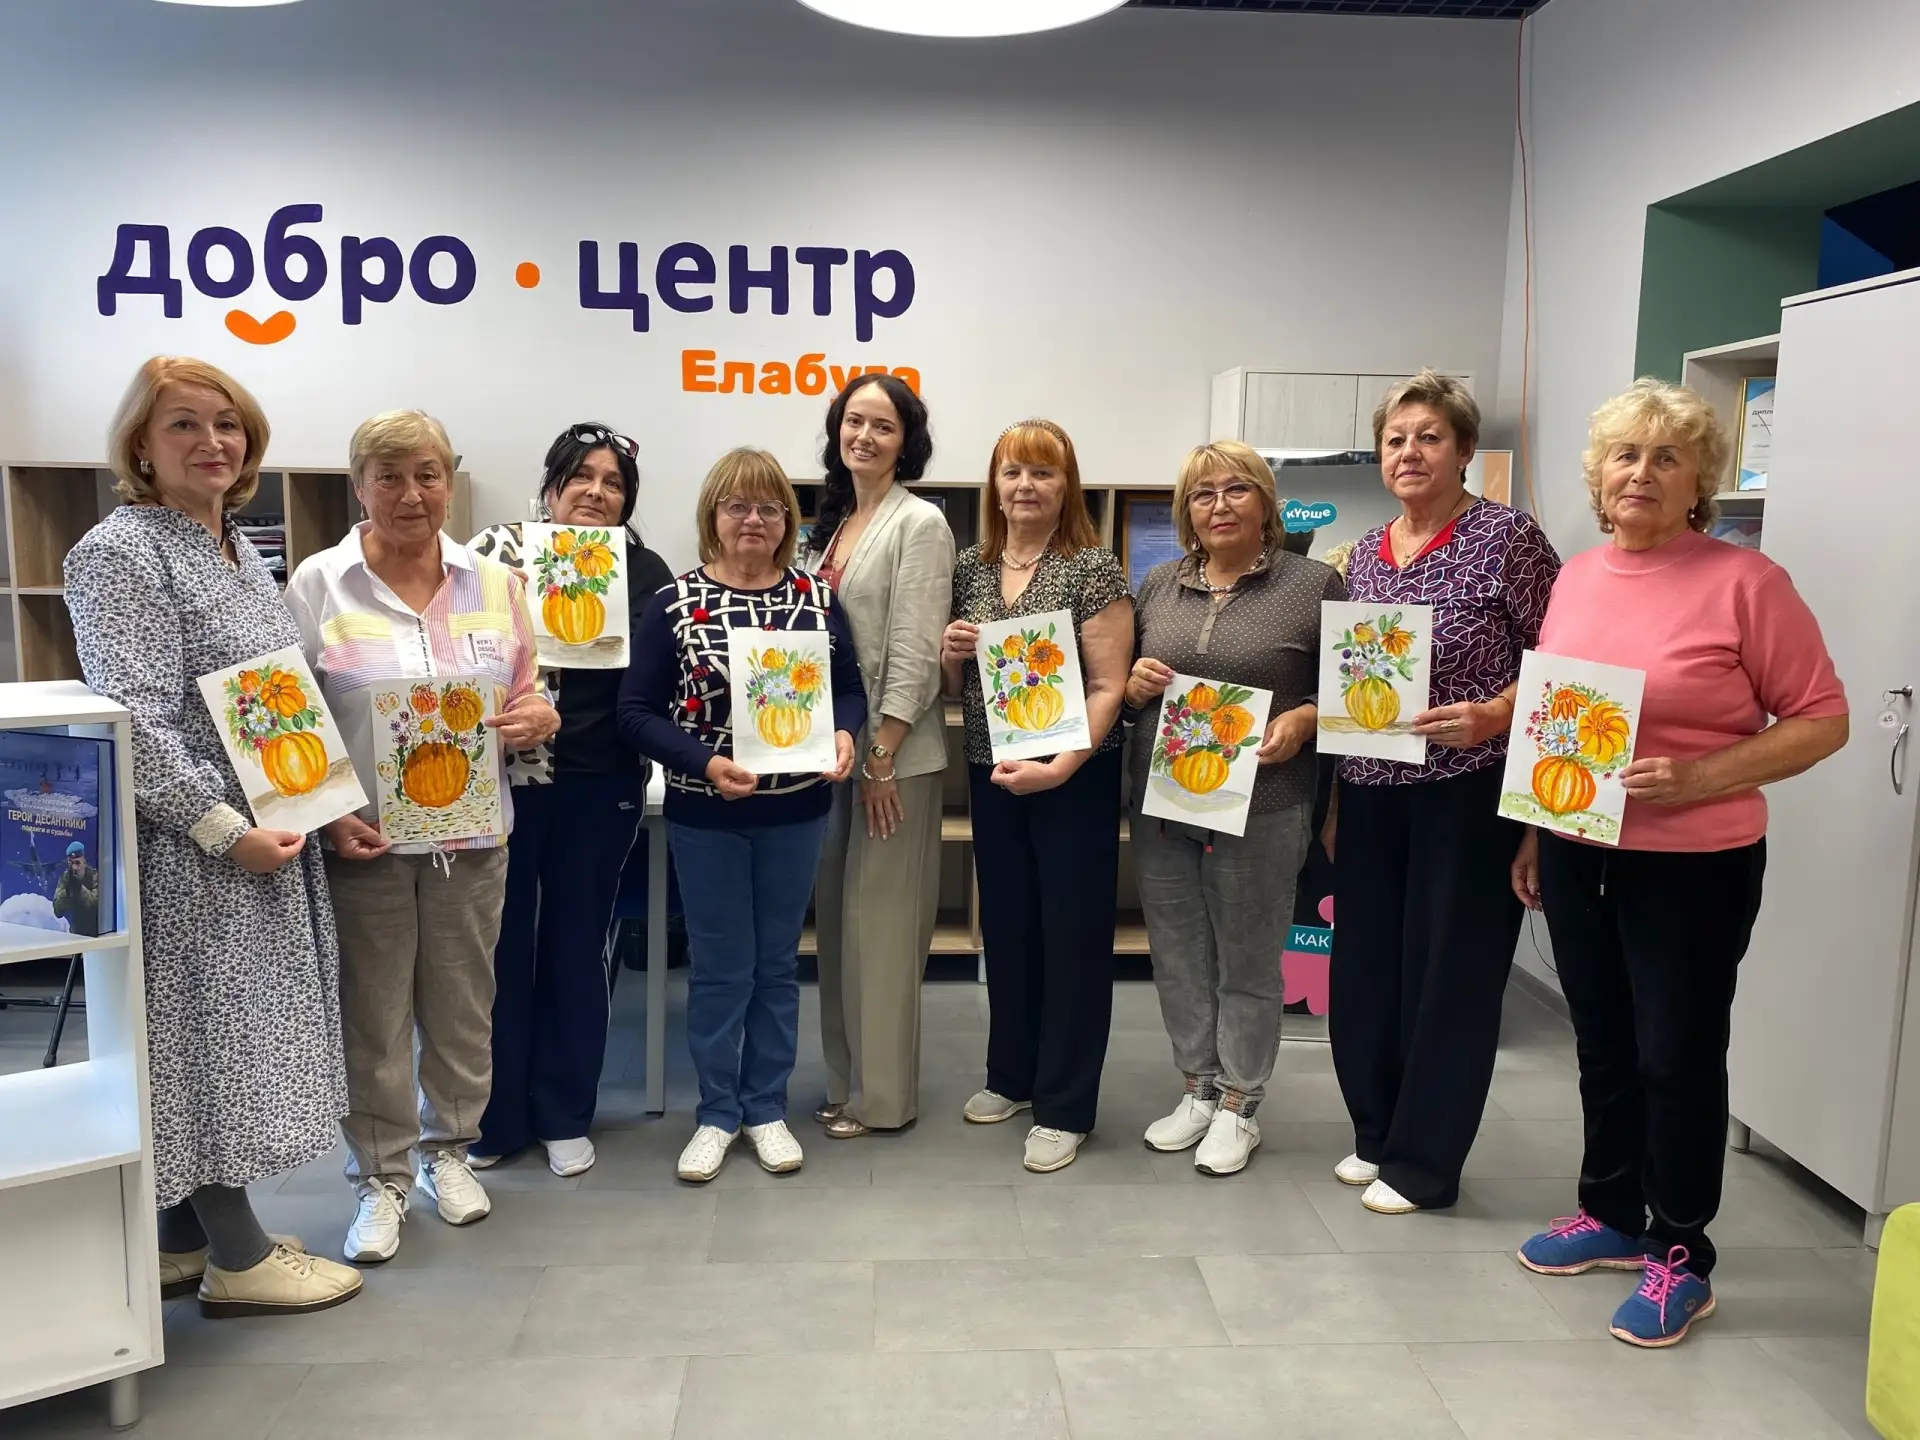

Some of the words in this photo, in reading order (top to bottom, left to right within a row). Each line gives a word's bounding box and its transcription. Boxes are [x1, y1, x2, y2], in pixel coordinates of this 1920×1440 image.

[96, 203, 477, 326] добро
[578, 239, 917, 342] центр
[35, 812, 87, 830] ДЕСАНТНИКИ
[1294, 932, 1330, 948] КАК
